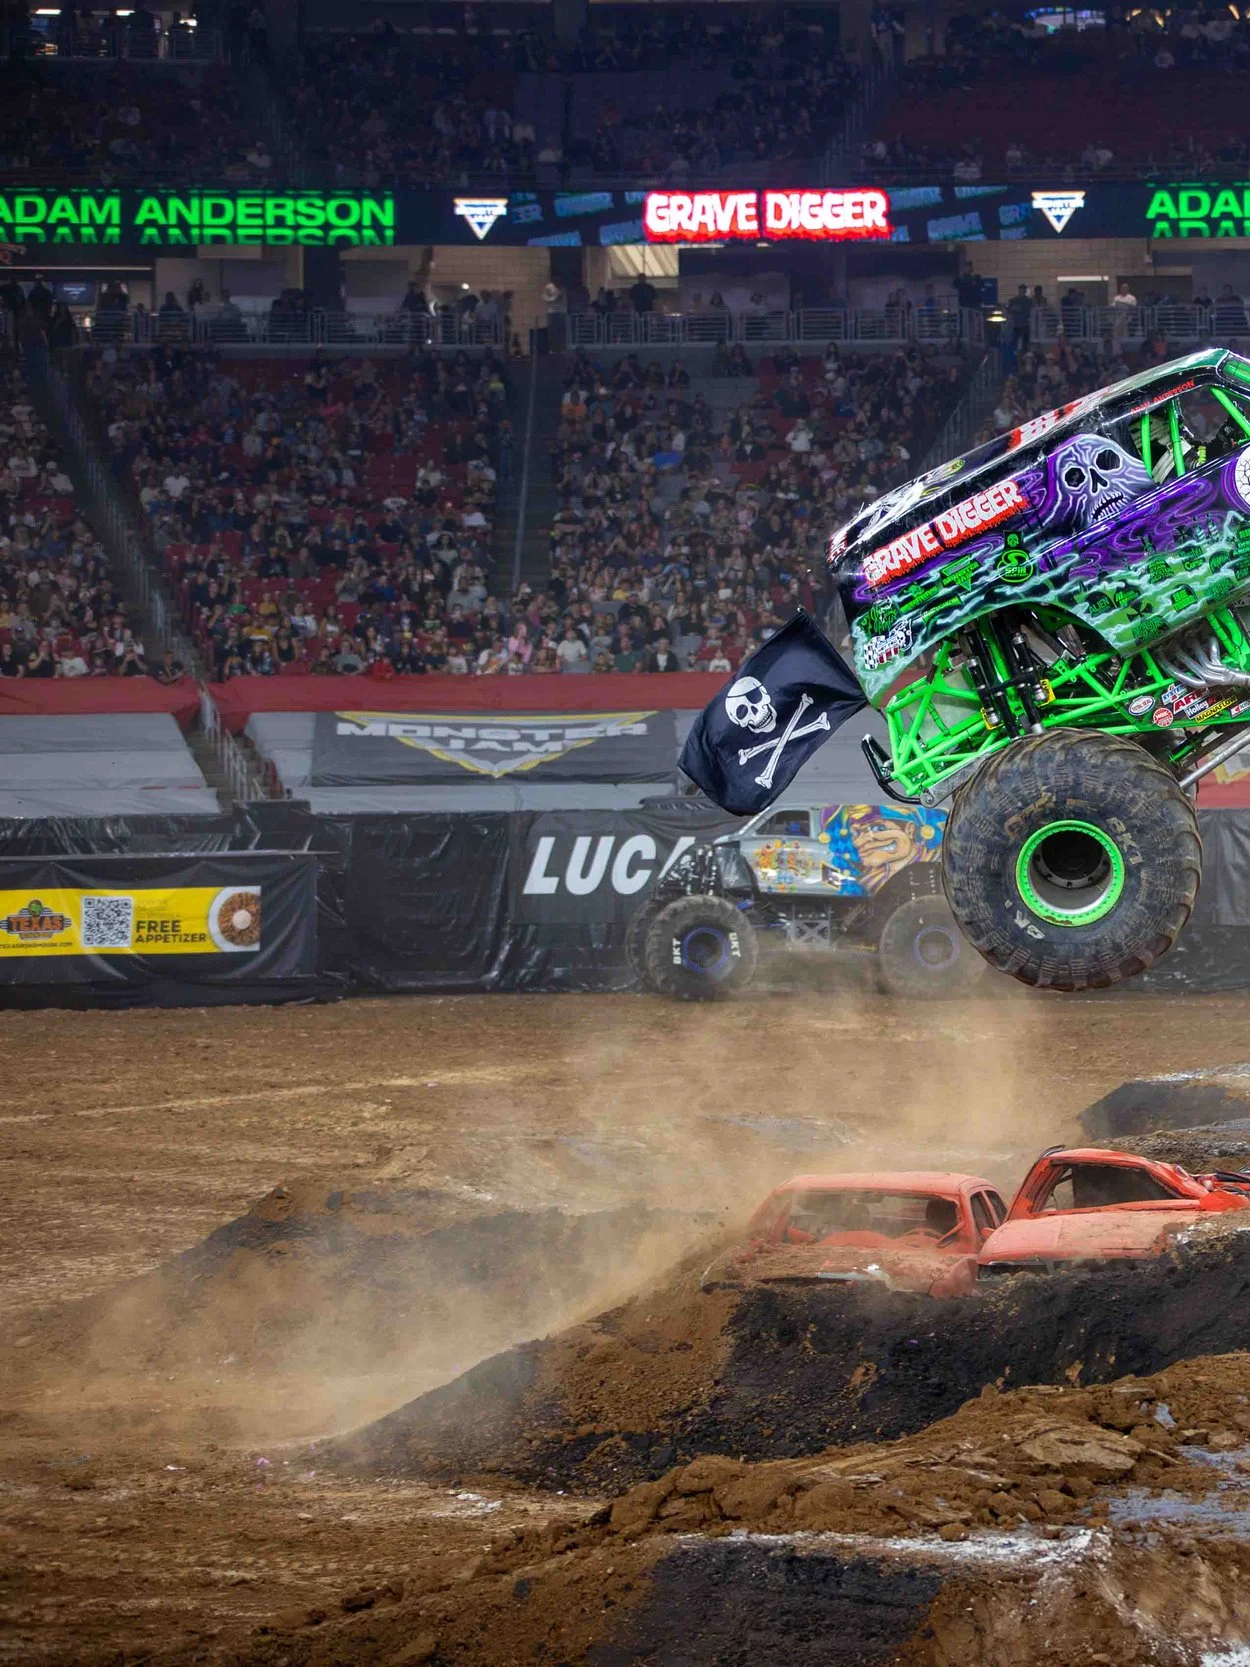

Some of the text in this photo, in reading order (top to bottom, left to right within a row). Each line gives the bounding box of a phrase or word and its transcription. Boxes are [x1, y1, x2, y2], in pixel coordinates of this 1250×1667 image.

[134, 196, 394, 227] ANDERSON
[645, 191, 759, 236] GRAVE
[764, 189, 891, 236] DIGGER
[862, 523, 941, 586] GRAVE
[935, 480, 1026, 546] DIGGER
[1185, 700, 1208, 716] Holley
[1195, 695, 1237, 723] MAGNAFLOW
[337, 721, 648, 741] MONSTER
[449, 738, 564, 752] JAM
[8, 916, 65, 933] TEXAS
[136, 919, 181, 933] FREE
[135, 932, 207, 944] APPETIZER
